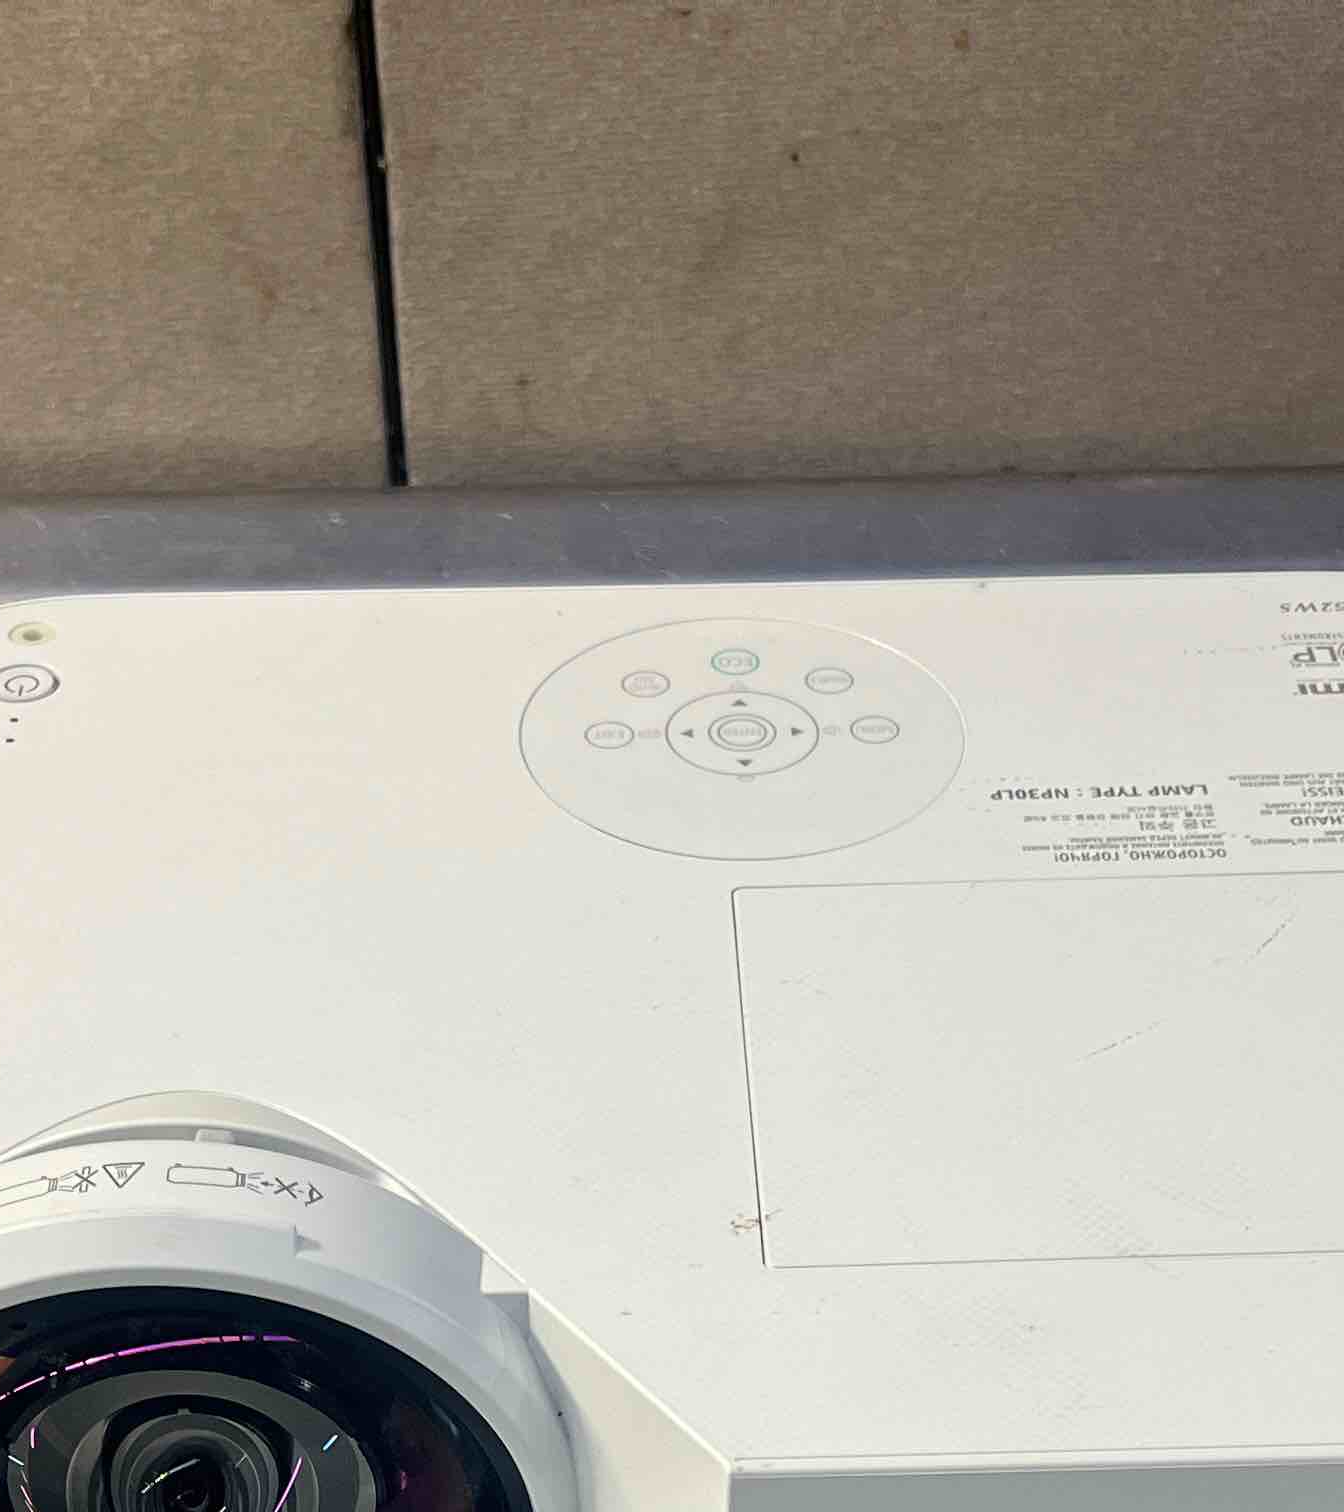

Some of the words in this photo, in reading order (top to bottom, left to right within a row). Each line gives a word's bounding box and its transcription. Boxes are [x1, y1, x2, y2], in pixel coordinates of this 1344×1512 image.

[990, 787, 1070, 801] NP30LP
[1091, 785, 1142, 799] TYPE
[1148, 784, 1209, 797] LAMP
